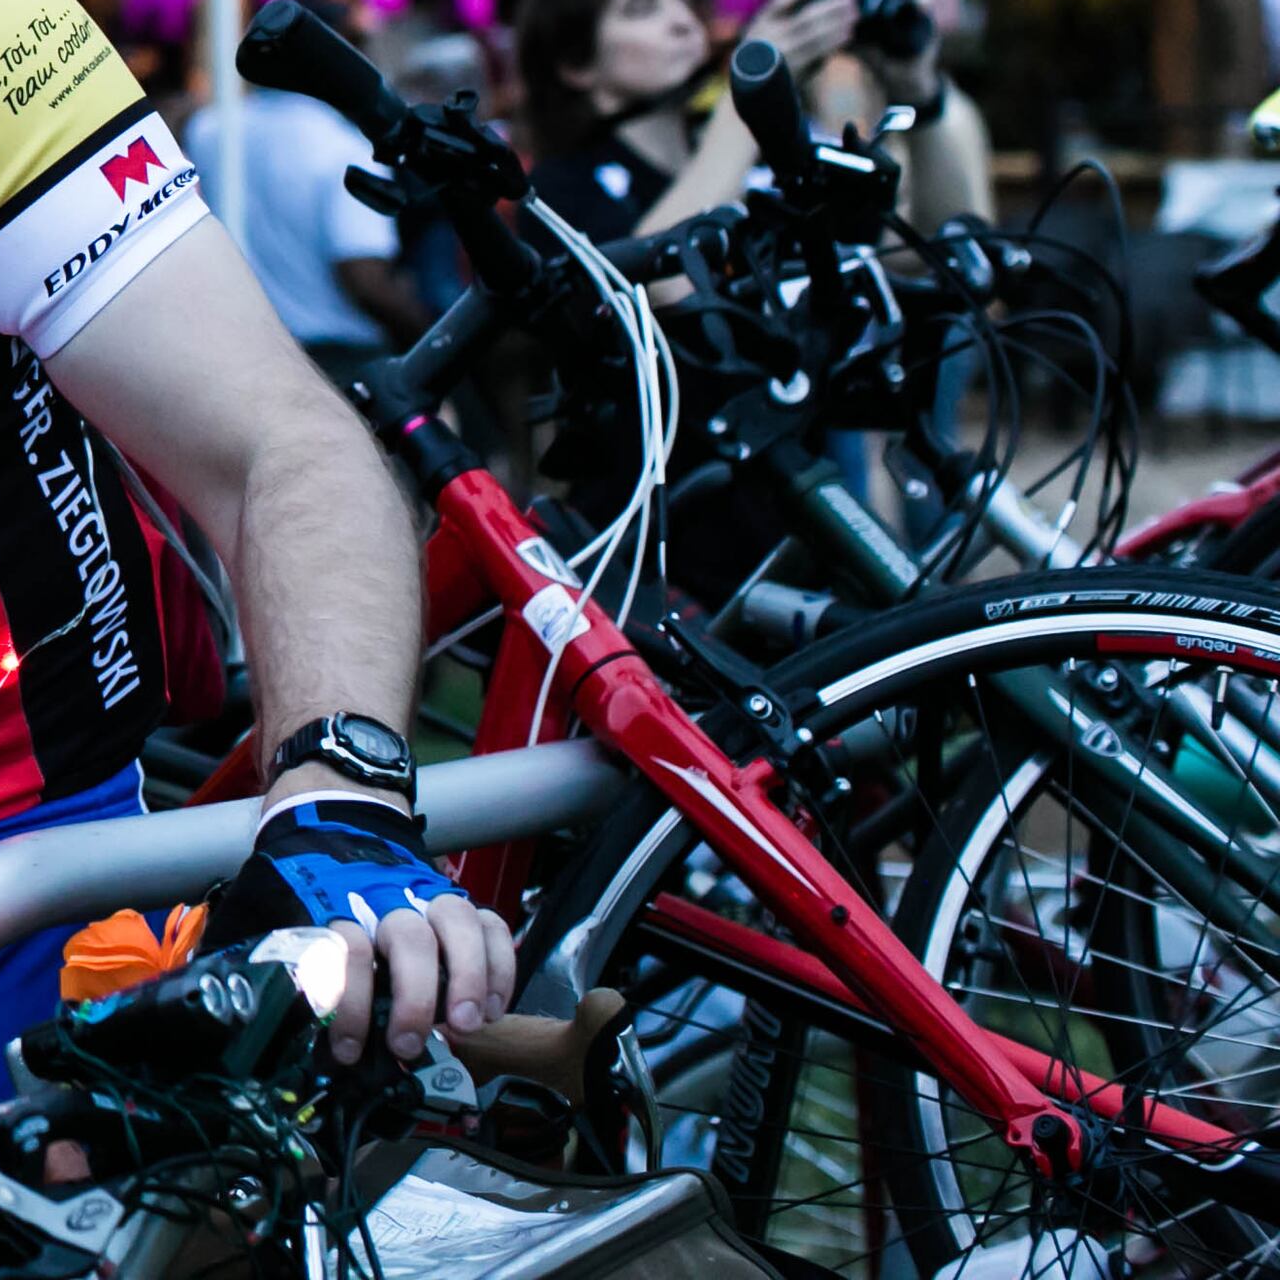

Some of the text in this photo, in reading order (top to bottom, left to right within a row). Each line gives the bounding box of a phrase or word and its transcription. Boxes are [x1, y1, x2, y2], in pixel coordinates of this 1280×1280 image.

[28, 8, 57, 42] Toi
[3, 62, 58, 116] Team
[44, 212, 131, 298] EDDY
[37, 449, 141, 711] ZIEGLOWSKI
[1176, 634, 1237, 654] nebula
